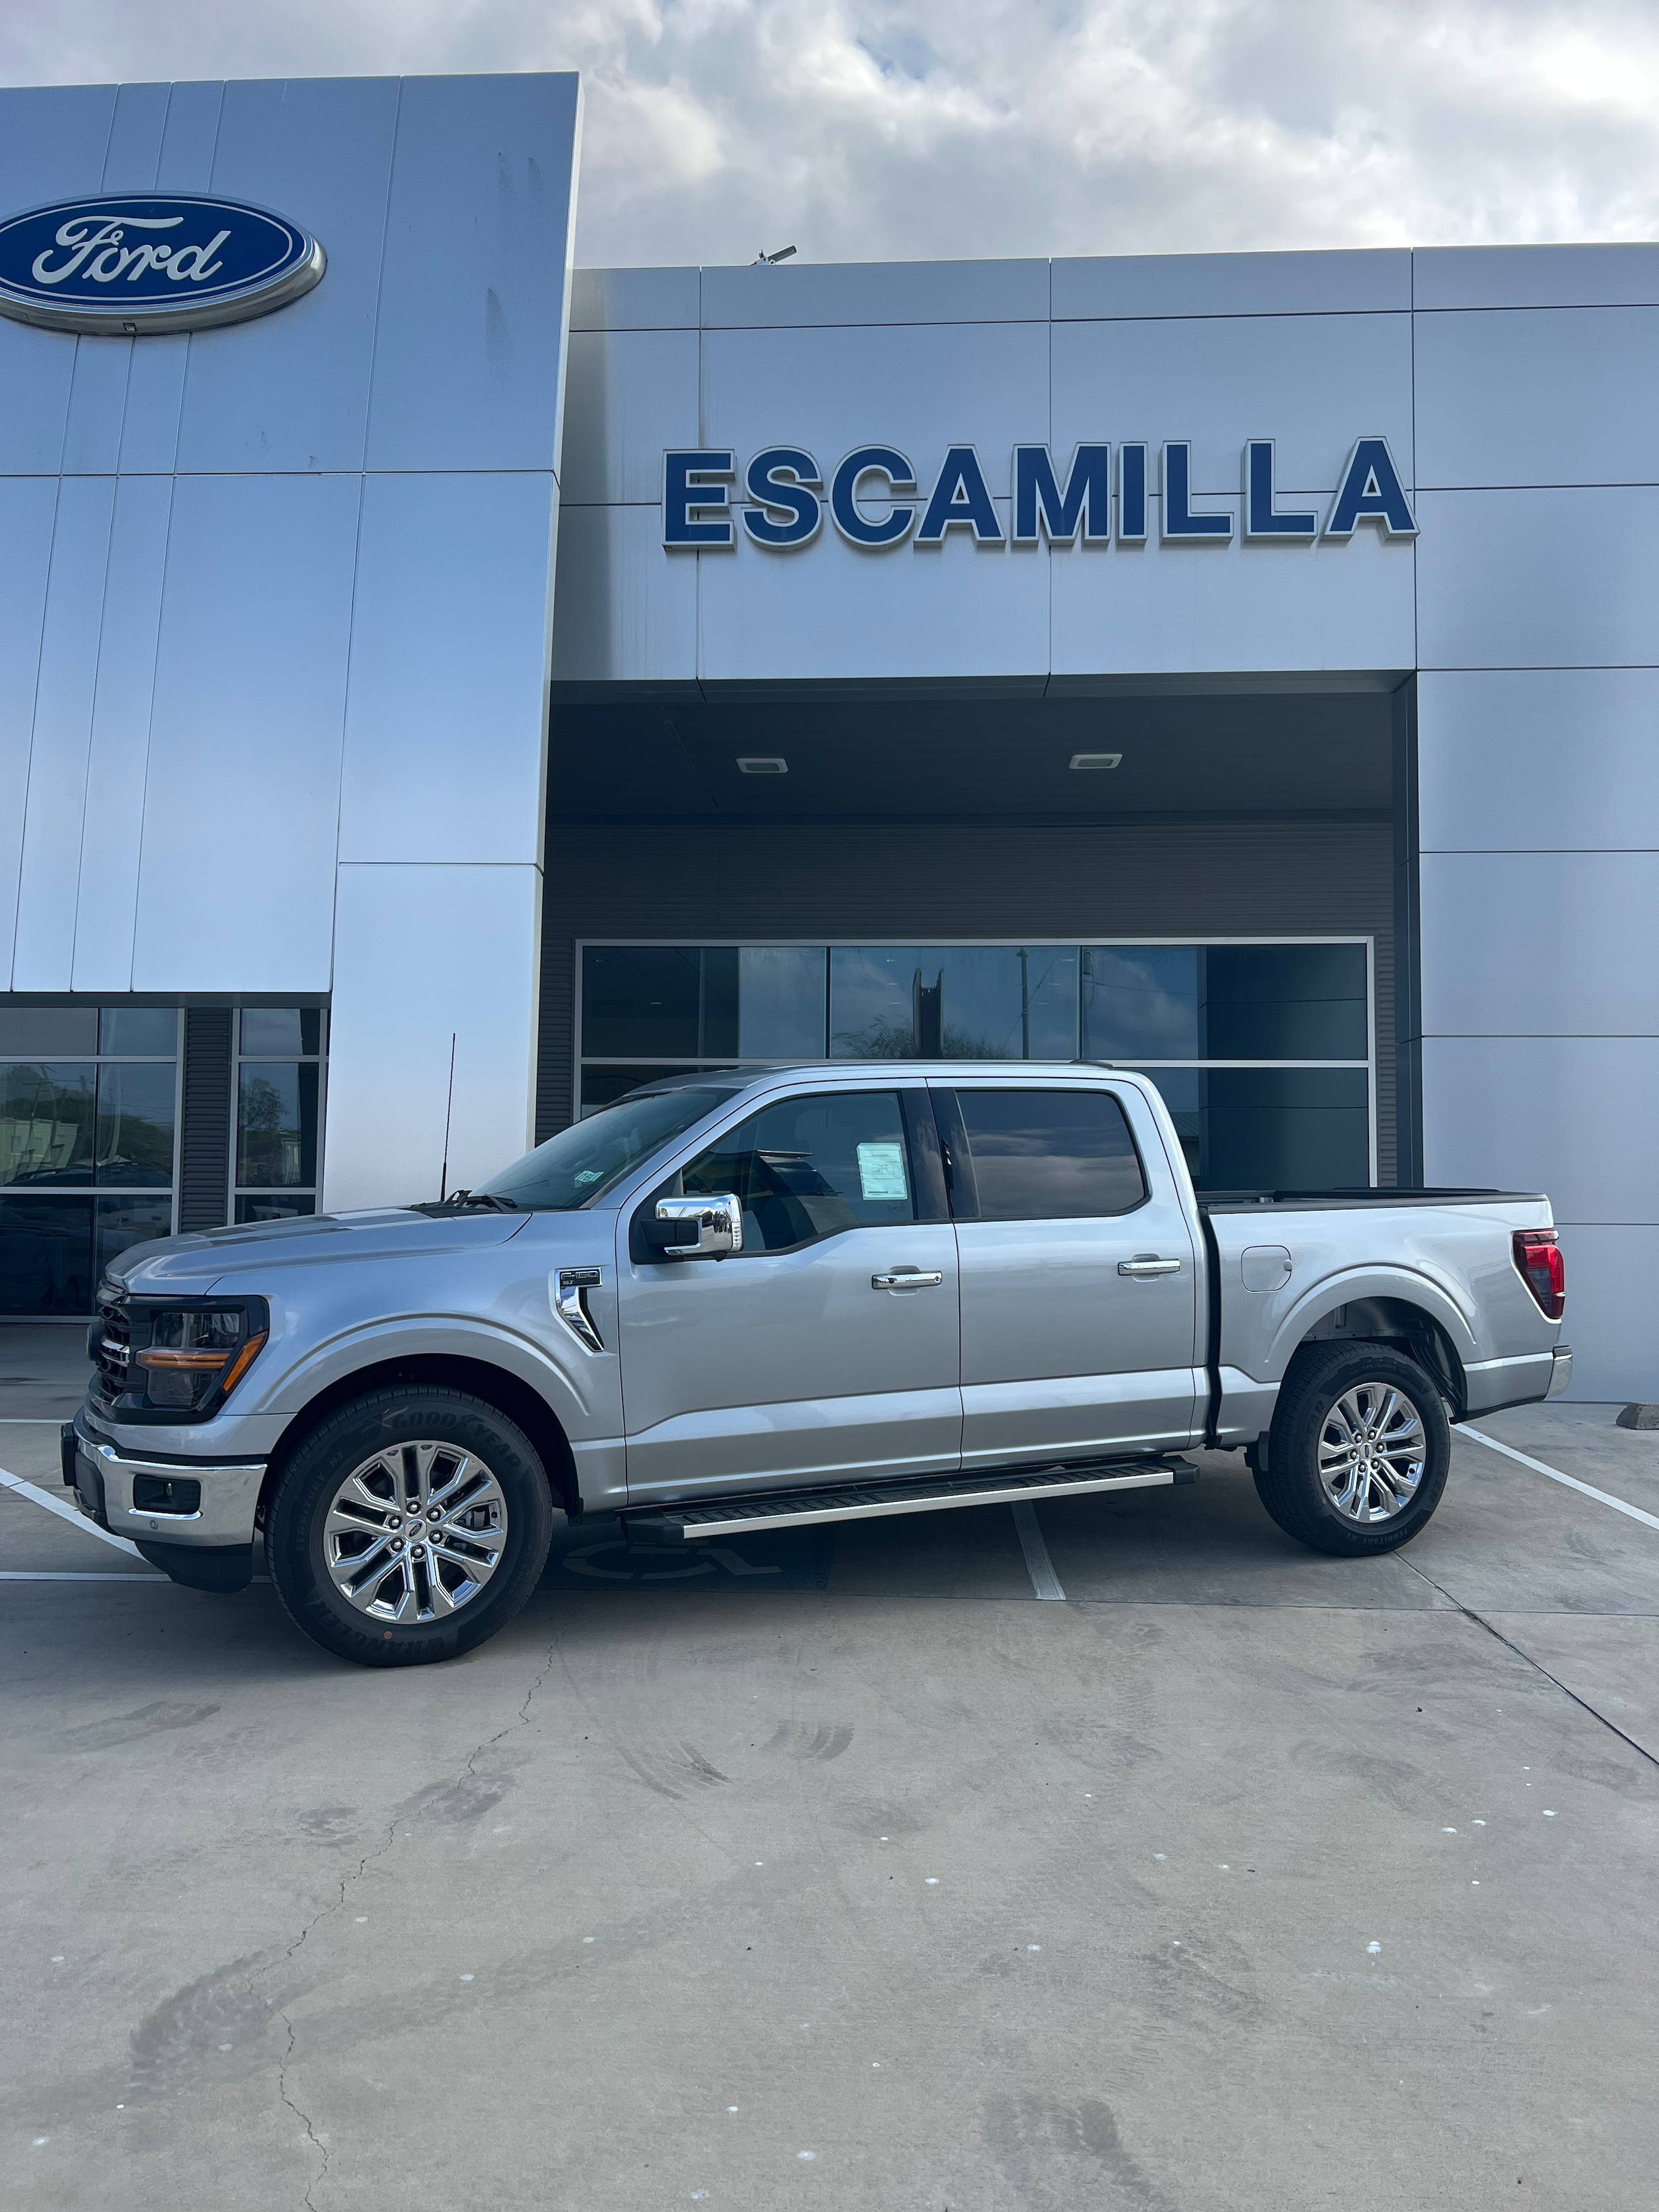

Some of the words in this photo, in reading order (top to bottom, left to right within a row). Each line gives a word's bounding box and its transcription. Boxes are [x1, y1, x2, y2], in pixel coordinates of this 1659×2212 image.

[32, 216, 231, 284] Ford
[662, 436, 1421, 551] ESCAMILLA
[561, 1270, 599, 1280] F-150
